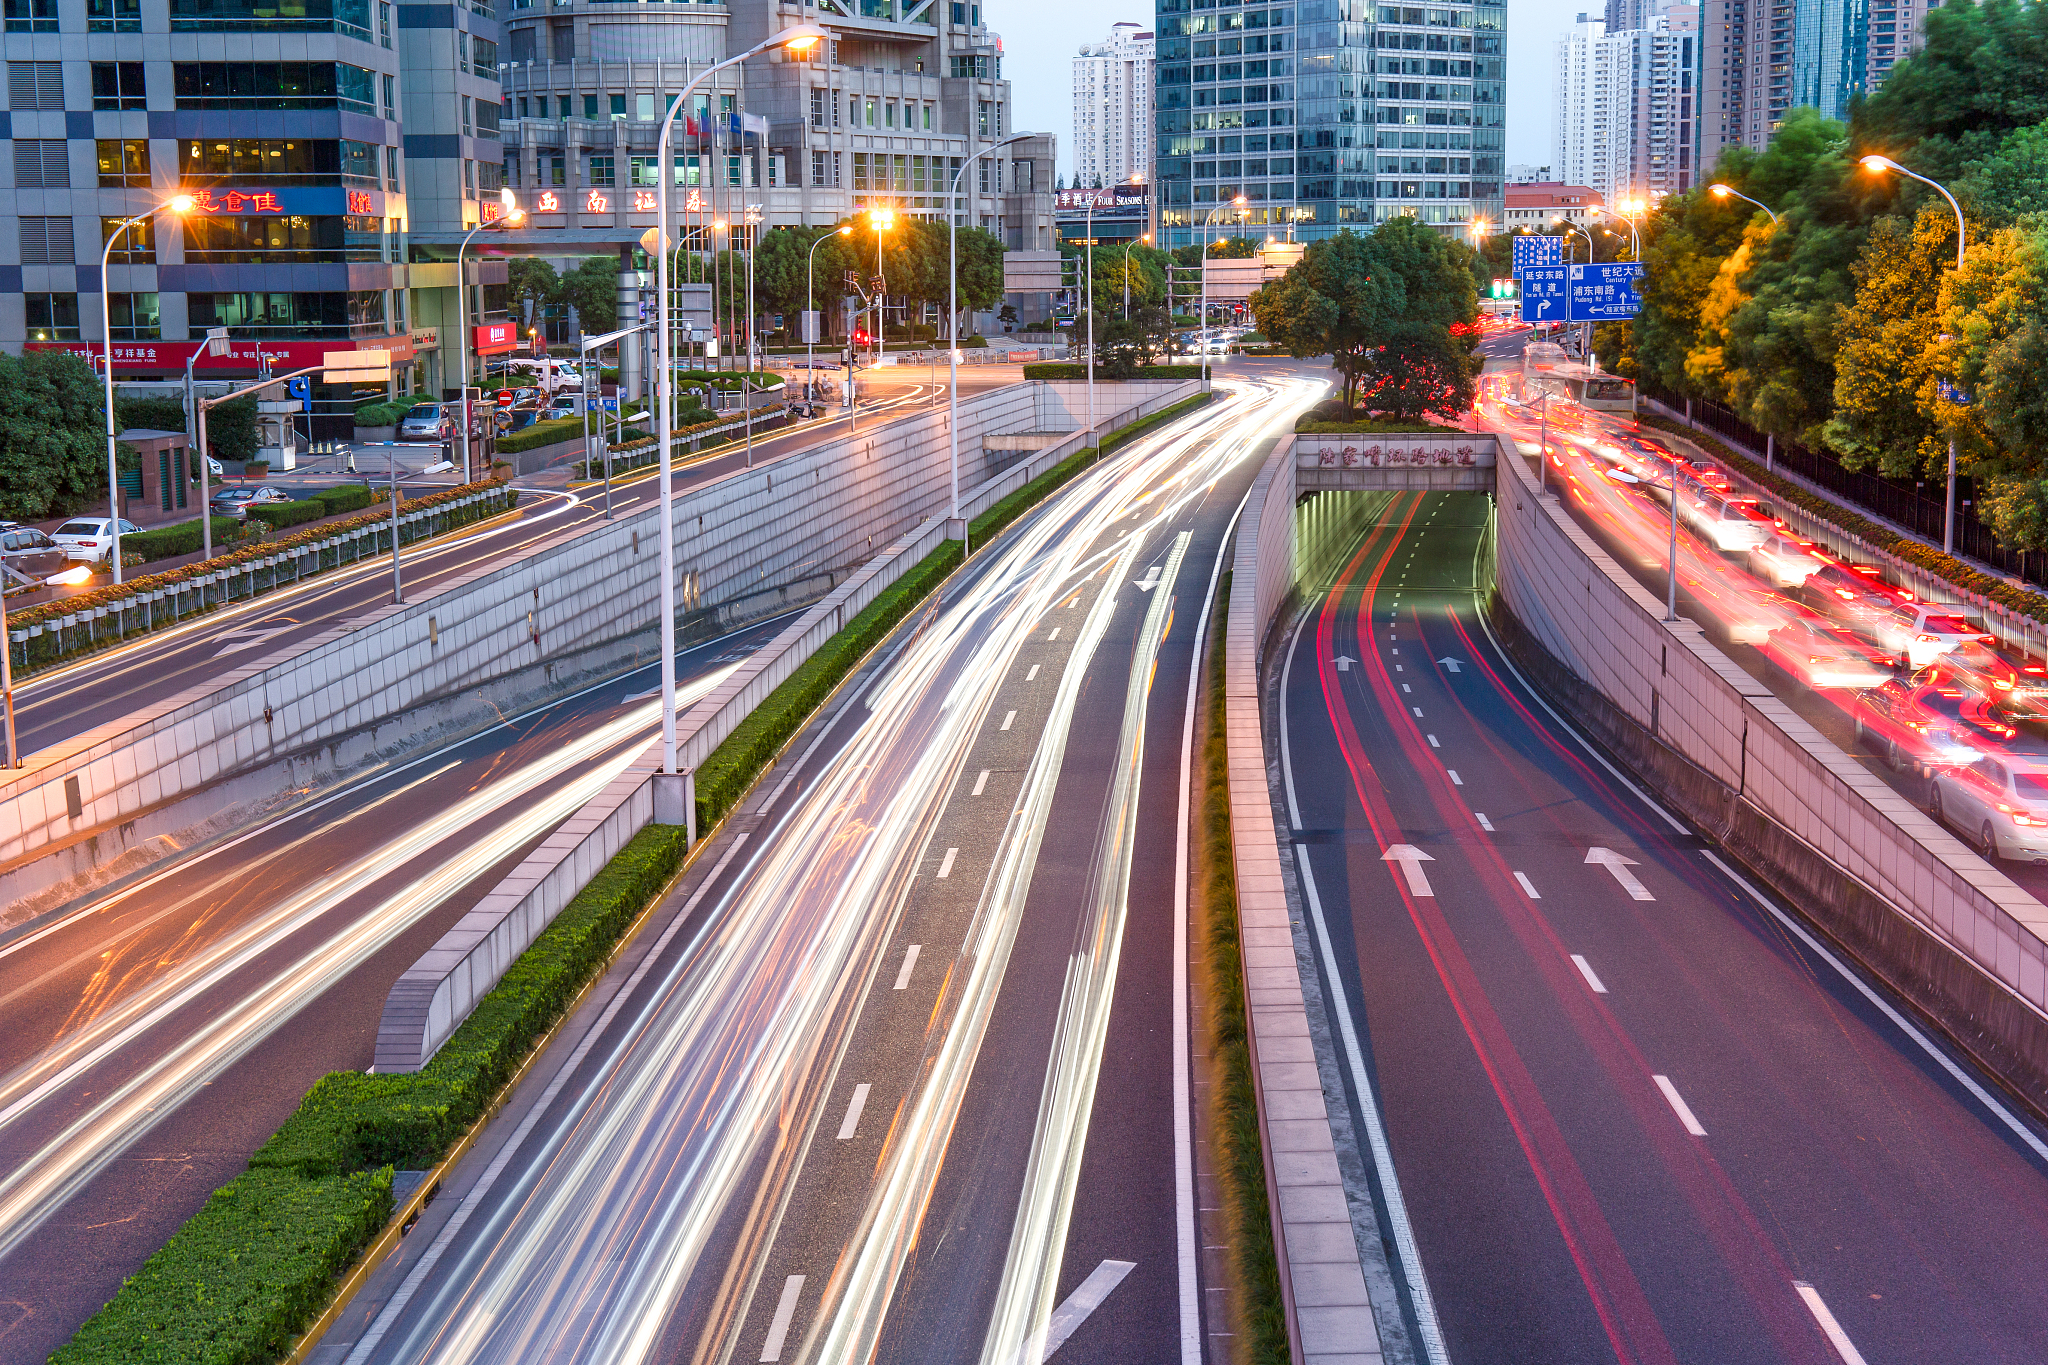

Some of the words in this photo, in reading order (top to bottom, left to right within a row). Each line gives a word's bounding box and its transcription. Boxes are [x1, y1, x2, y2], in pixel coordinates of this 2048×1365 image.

[538, 189, 708, 214] 西南证券
[1525, 270, 1564, 281] 延安东路
[1601, 266, 1645, 277] 世纪大道
[1573, 285, 1615, 297] 浦东南路
[1319, 444, 1476, 466] 陆家嘴环路地道
